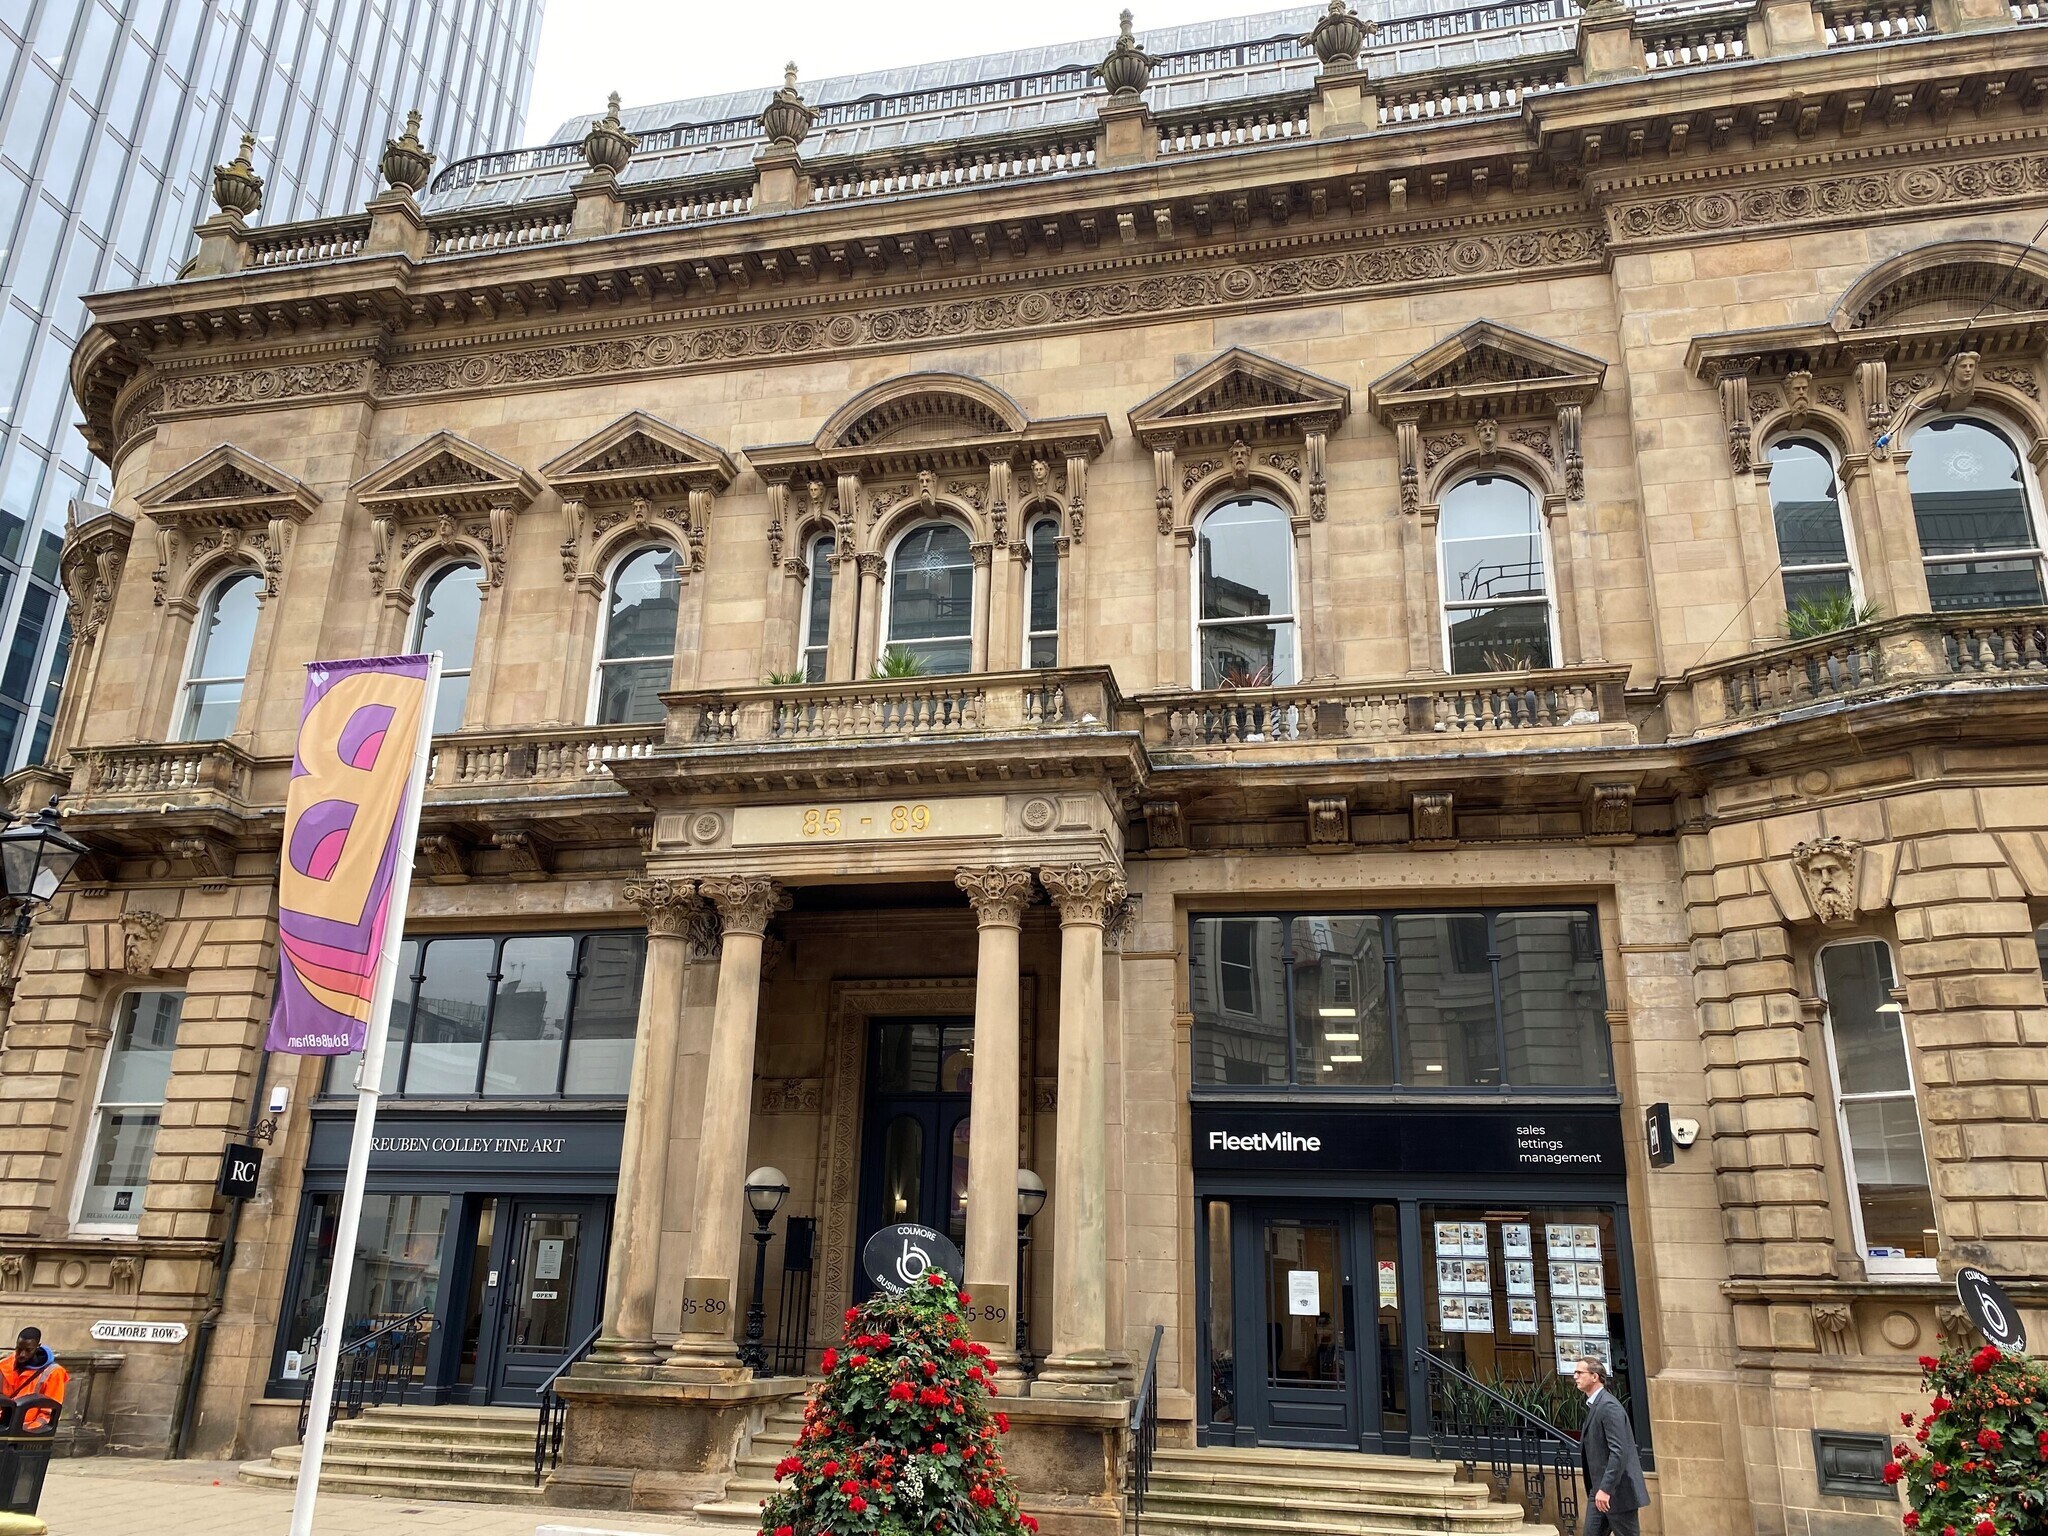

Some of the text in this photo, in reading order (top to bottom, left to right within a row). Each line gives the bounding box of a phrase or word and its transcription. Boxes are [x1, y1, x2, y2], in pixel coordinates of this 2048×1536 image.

[802, 808, 842, 837] 85
[890, 804, 931, 834] 89
[1516, 1125, 1546, 1135] sales
[370, 1137, 566, 1153] REUBEN COLLEY FINE ART
[1209, 1131, 1321, 1152] FleetMilne
[1518, 1138, 1563, 1151] lettings
[1519, 1153, 1602, 1165] management
[230, 1160, 257, 1183] RC
[897, 1226, 937, 1242] COLMORE
[682, 1297, 726, 1315] 85-89
[98, 1326, 147, 1338] COLMORE
[151, 1328, 174, 1338] ROW
